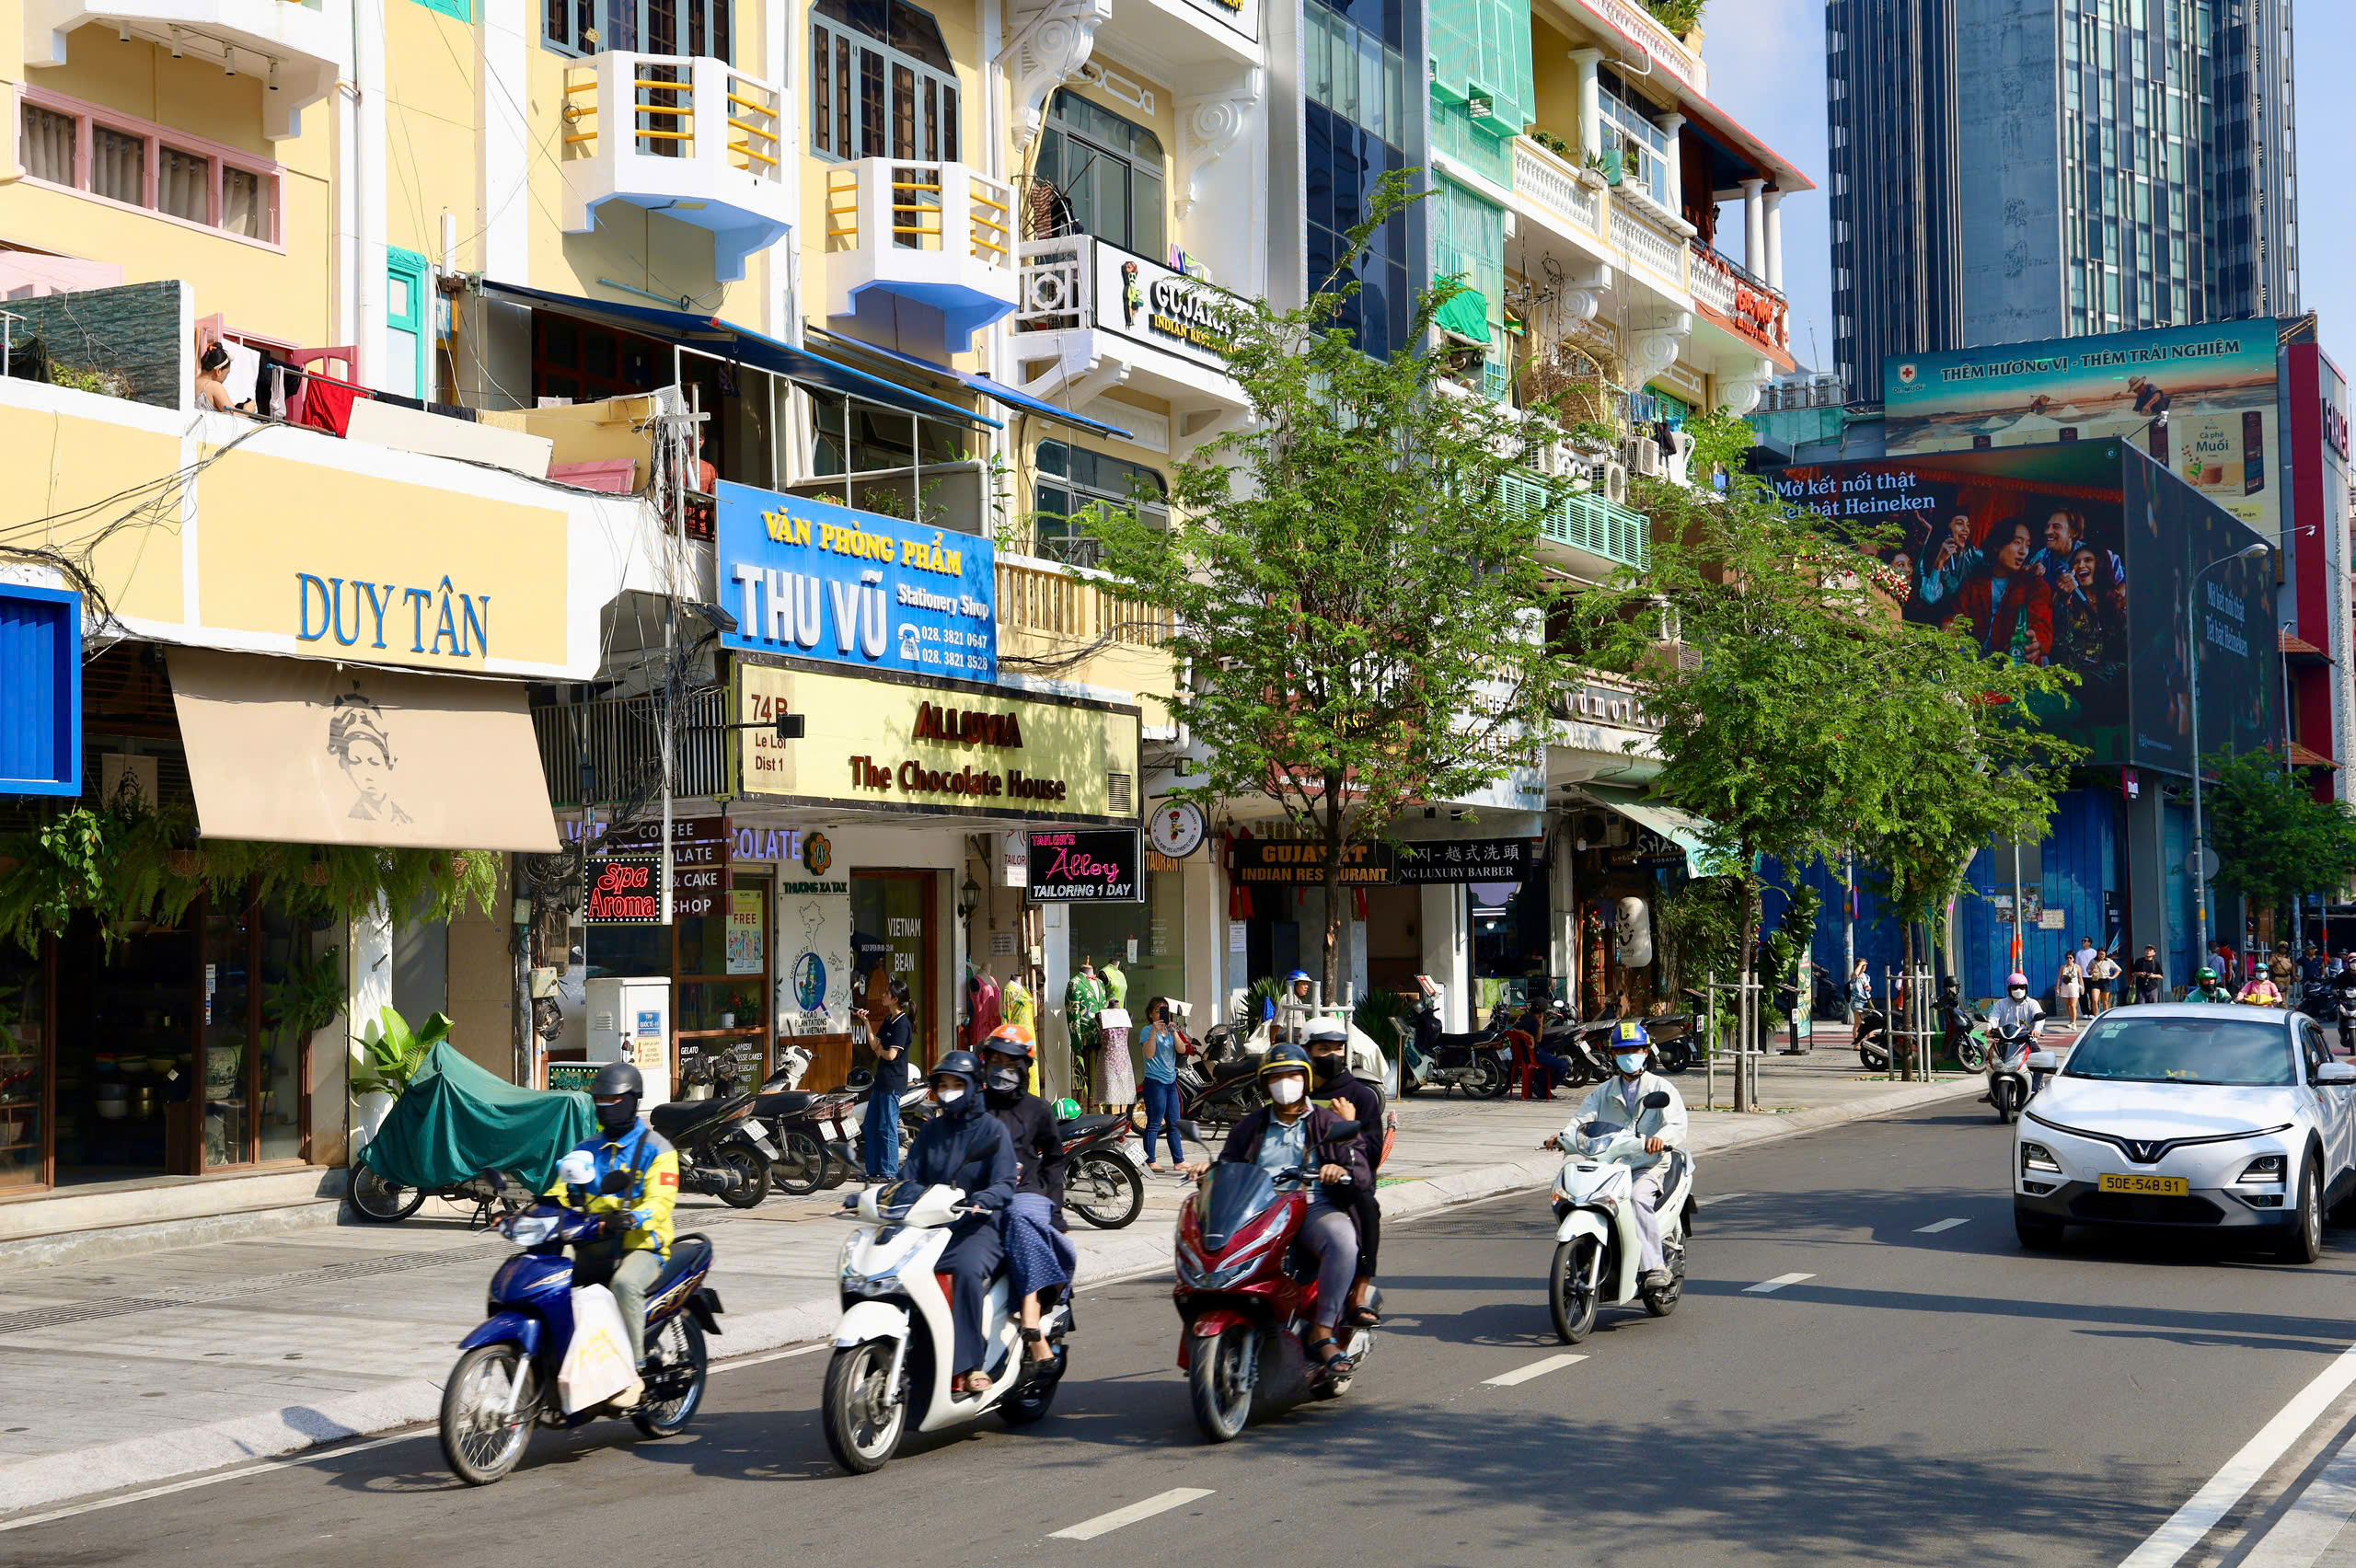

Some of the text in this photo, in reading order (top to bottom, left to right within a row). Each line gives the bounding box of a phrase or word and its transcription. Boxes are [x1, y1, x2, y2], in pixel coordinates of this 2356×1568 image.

[1154, 315, 1187, 339] INDIAN
[1942, 364, 1986, 382] THÊM
[1988, 360, 2050, 378] HƯƠNG
[2050, 356, 2069, 375] VỊ
[2081, 349, 2127, 367] THÊM
[2129, 343, 2168, 364] TRẢI
[2171, 339, 2240, 362] NGHIỆM
[2196, 438, 2229, 452] Muối
[1775, 471, 1916, 498] Mở kết nối thật
[1845, 495, 1935, 515] Heineken
[762, 505, 963, 577] VĂN PHÒNG PHẨM
[732, 562, 888, 658] THU VŨ
[897, 583, 989, 621] Stationery Shop
[295, 571, 491, 658] DUY TÂN
[921, 626, 987, 649] 028. 3821 0647
[922, 647, 988, 671] 028. 3821 8528
[914, 700, 1023, 749] ALLUVIA
[755, 733, 768, 749] Le
[755, 755, 784, 772] Dist 1
[849, 755, 1067, 801] The Chocolate House
[639, 823, 694, 839] COFEE
[1032, 834, 1076, 847] TAILOR'S
[1045, 847, 1120, 883] Alley
[1242, 868, 1293, 882] INDIAN
[1419, 867, 1466, 879] LUXURY
[1467, 866, 1514, 878] BARBER
[597, 862, 649, 894] Spa
[684, 872, 718, 887] CAKE
[1033, 883, 1132, 898] TAILORING 1 DAY
[587, 887, 656, 917] Aroma
[672, 898, 712, 915] SHOP
[733, 913, 756, 925] FREE
[887, 917, 921, 937] VIETNAM
[790, 945, 810, 980] CHOCOLATE
[895, 952, 915, 972] BEAN
[794, 1019, 827, 1028] PLANTATIONS
[799, 1011, 818, 1020] CACAO
[806, 1026, 827, 1035] VIETNAM
[681, 1045, 699, 1055] GELATO
[748, 1052, 763, 1061] CAKES
[2107, 1177, 2178, 1193] 50E-548.91
